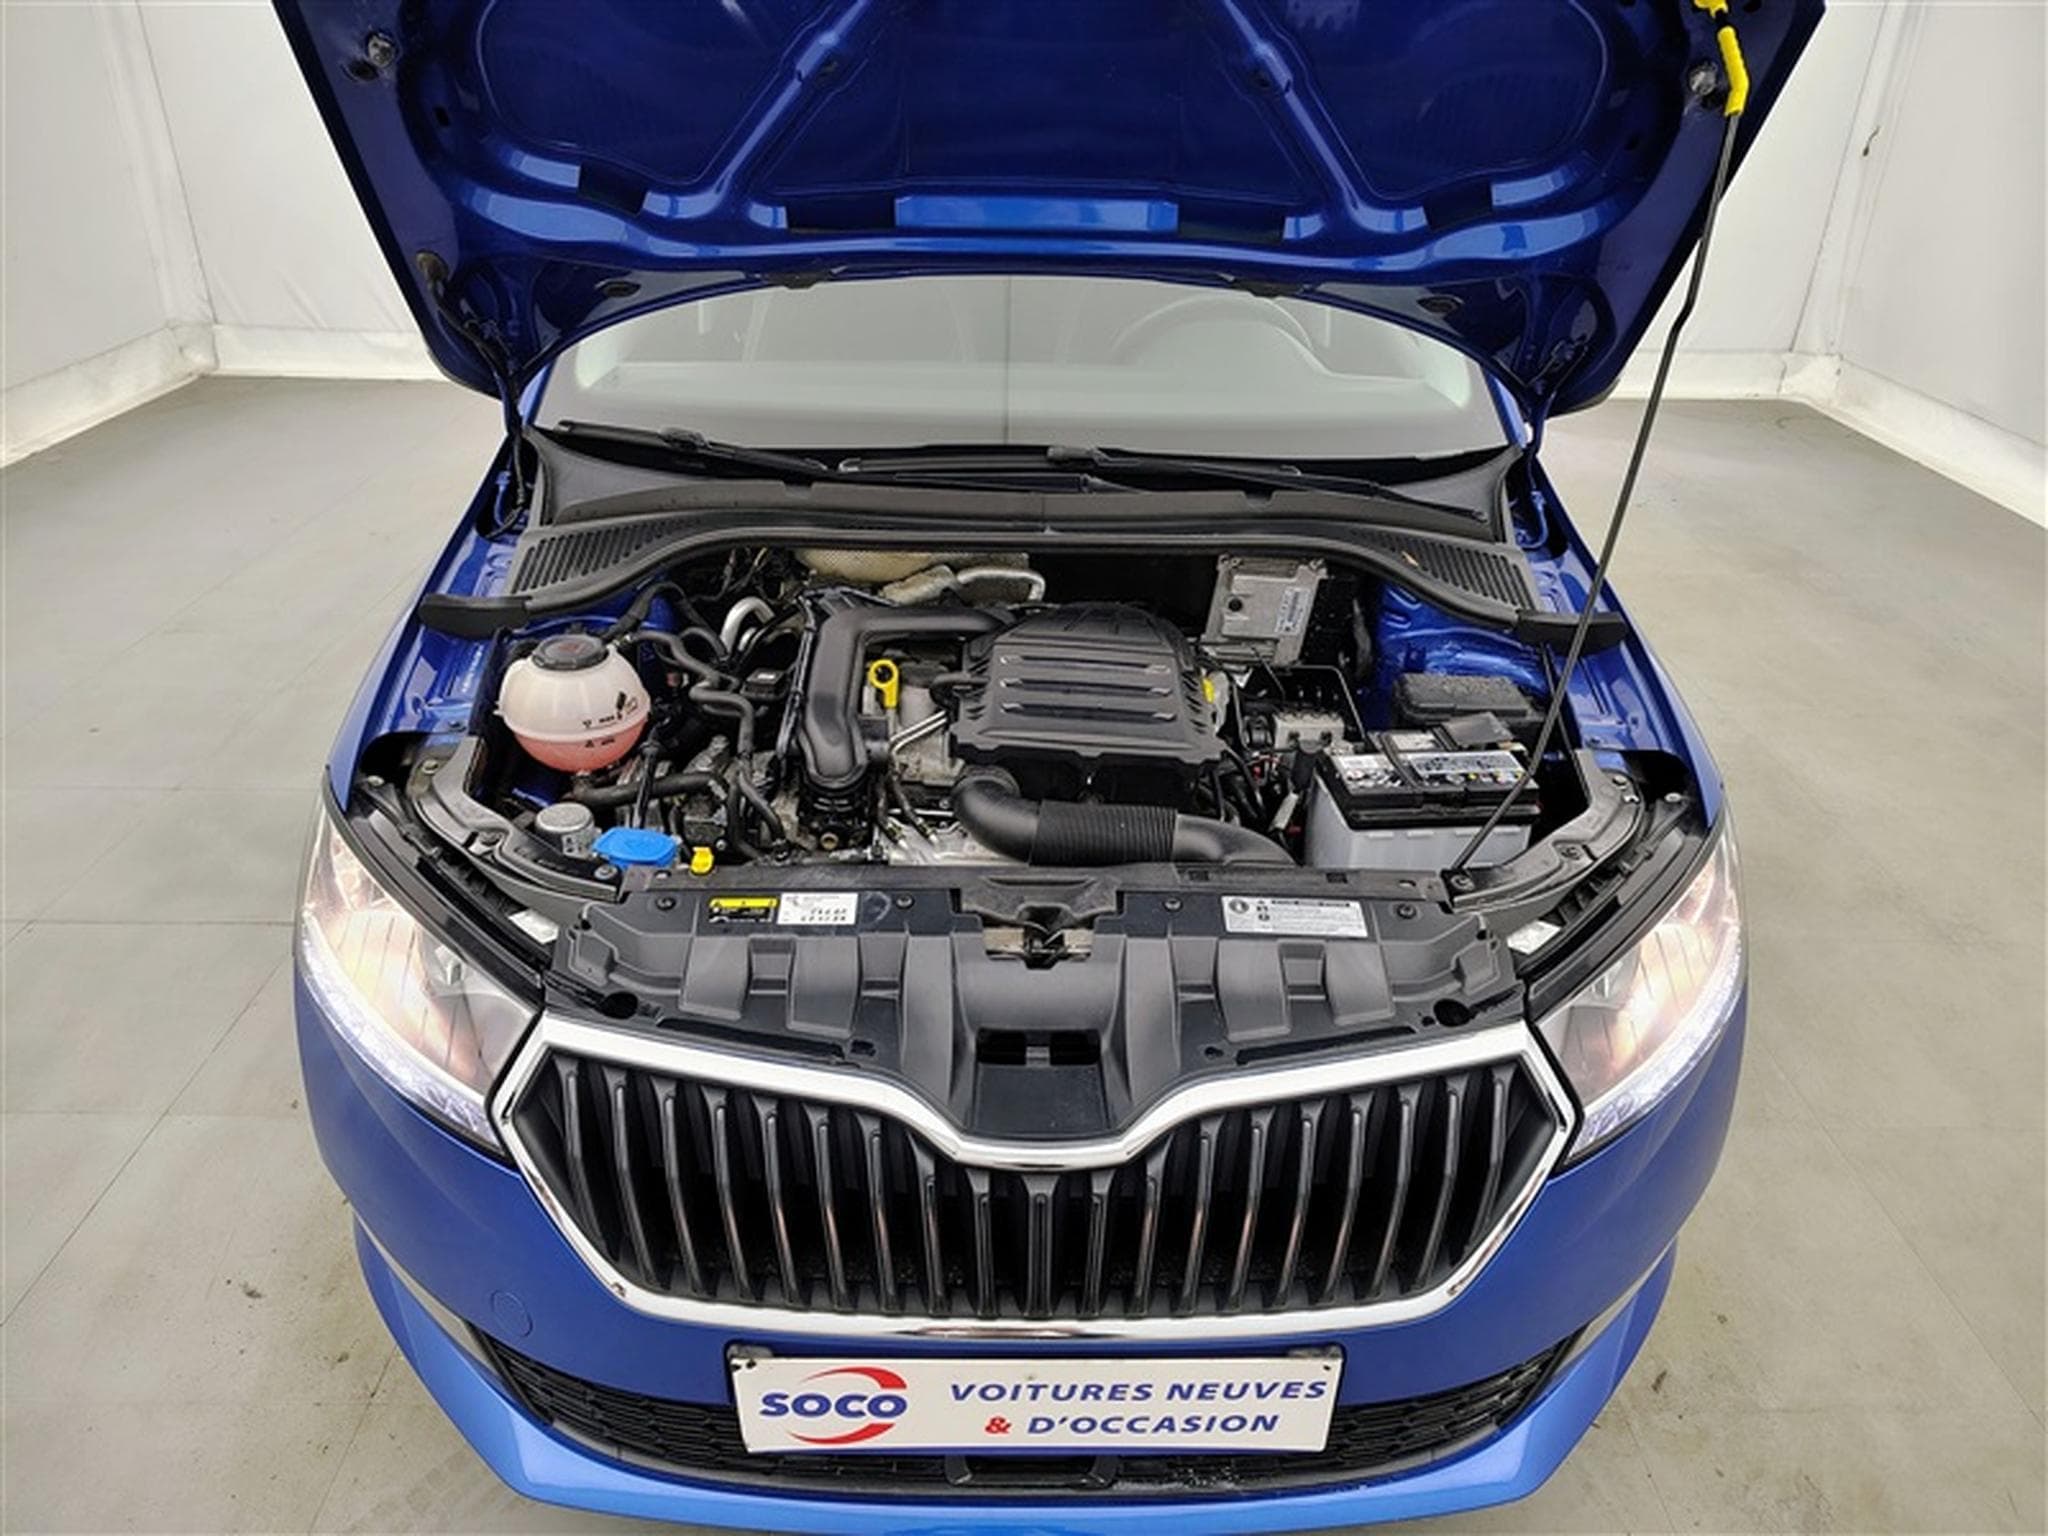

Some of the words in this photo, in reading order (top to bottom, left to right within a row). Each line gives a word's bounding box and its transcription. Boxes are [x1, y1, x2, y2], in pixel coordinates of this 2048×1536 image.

[951, 1384, 1153, 1401] VOITURES
[1167, 1381, 1327, 1400] NEUVES
[760, 1393, 907, 1418] SOCO
[985, 1416, 1012, 1434] &
[1027, 1415, 1279, 1434] D'OCCASION
